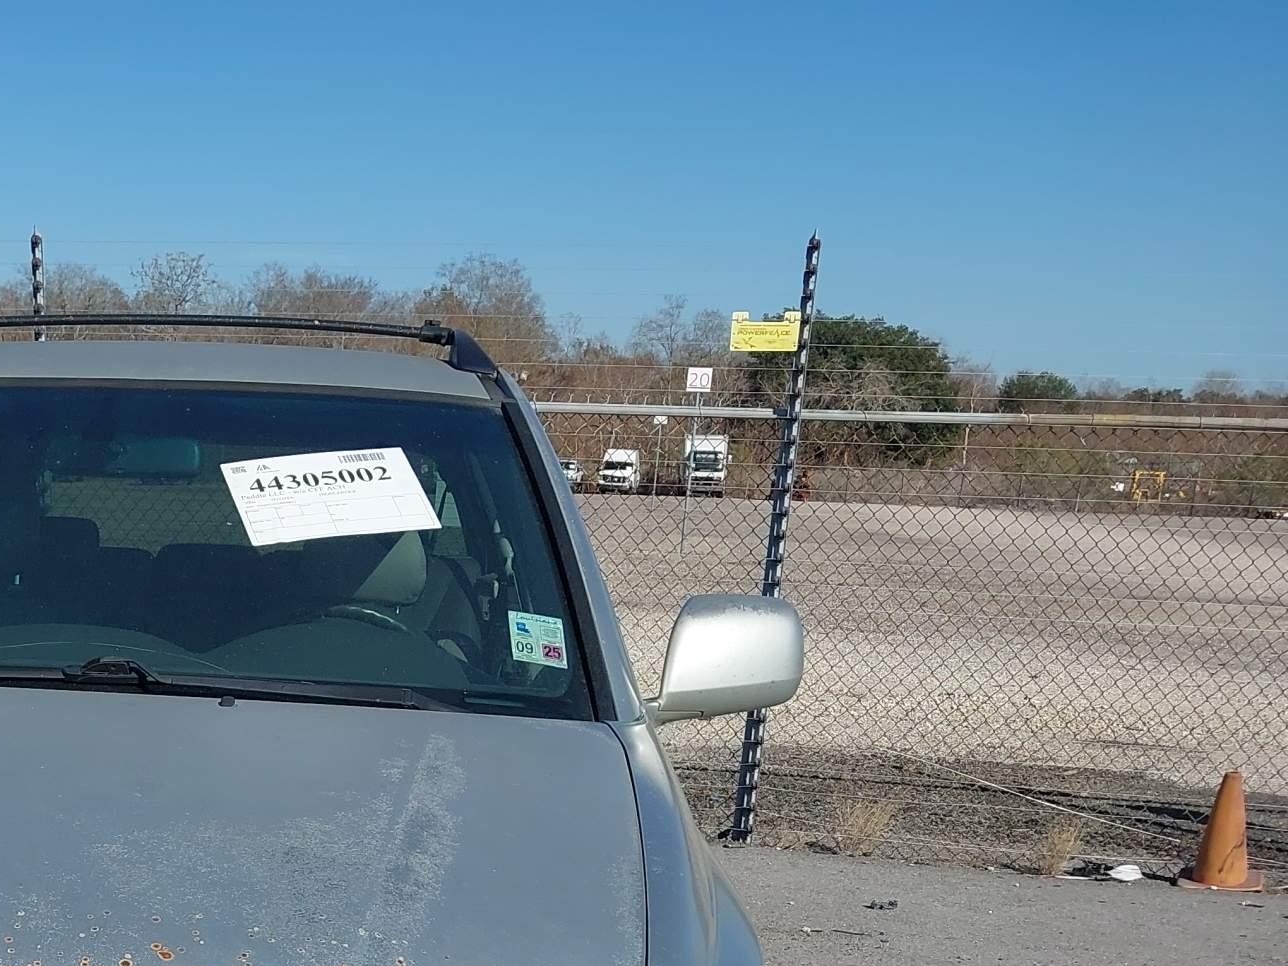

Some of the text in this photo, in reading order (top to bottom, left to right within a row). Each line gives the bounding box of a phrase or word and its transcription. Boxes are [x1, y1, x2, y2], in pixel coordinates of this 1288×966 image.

[688, 372, 710, 388] 20
[249, 466, 392, 493] 44305002
[516, 640, 534, 654] 09
[543, 645, 562, 660] 25
